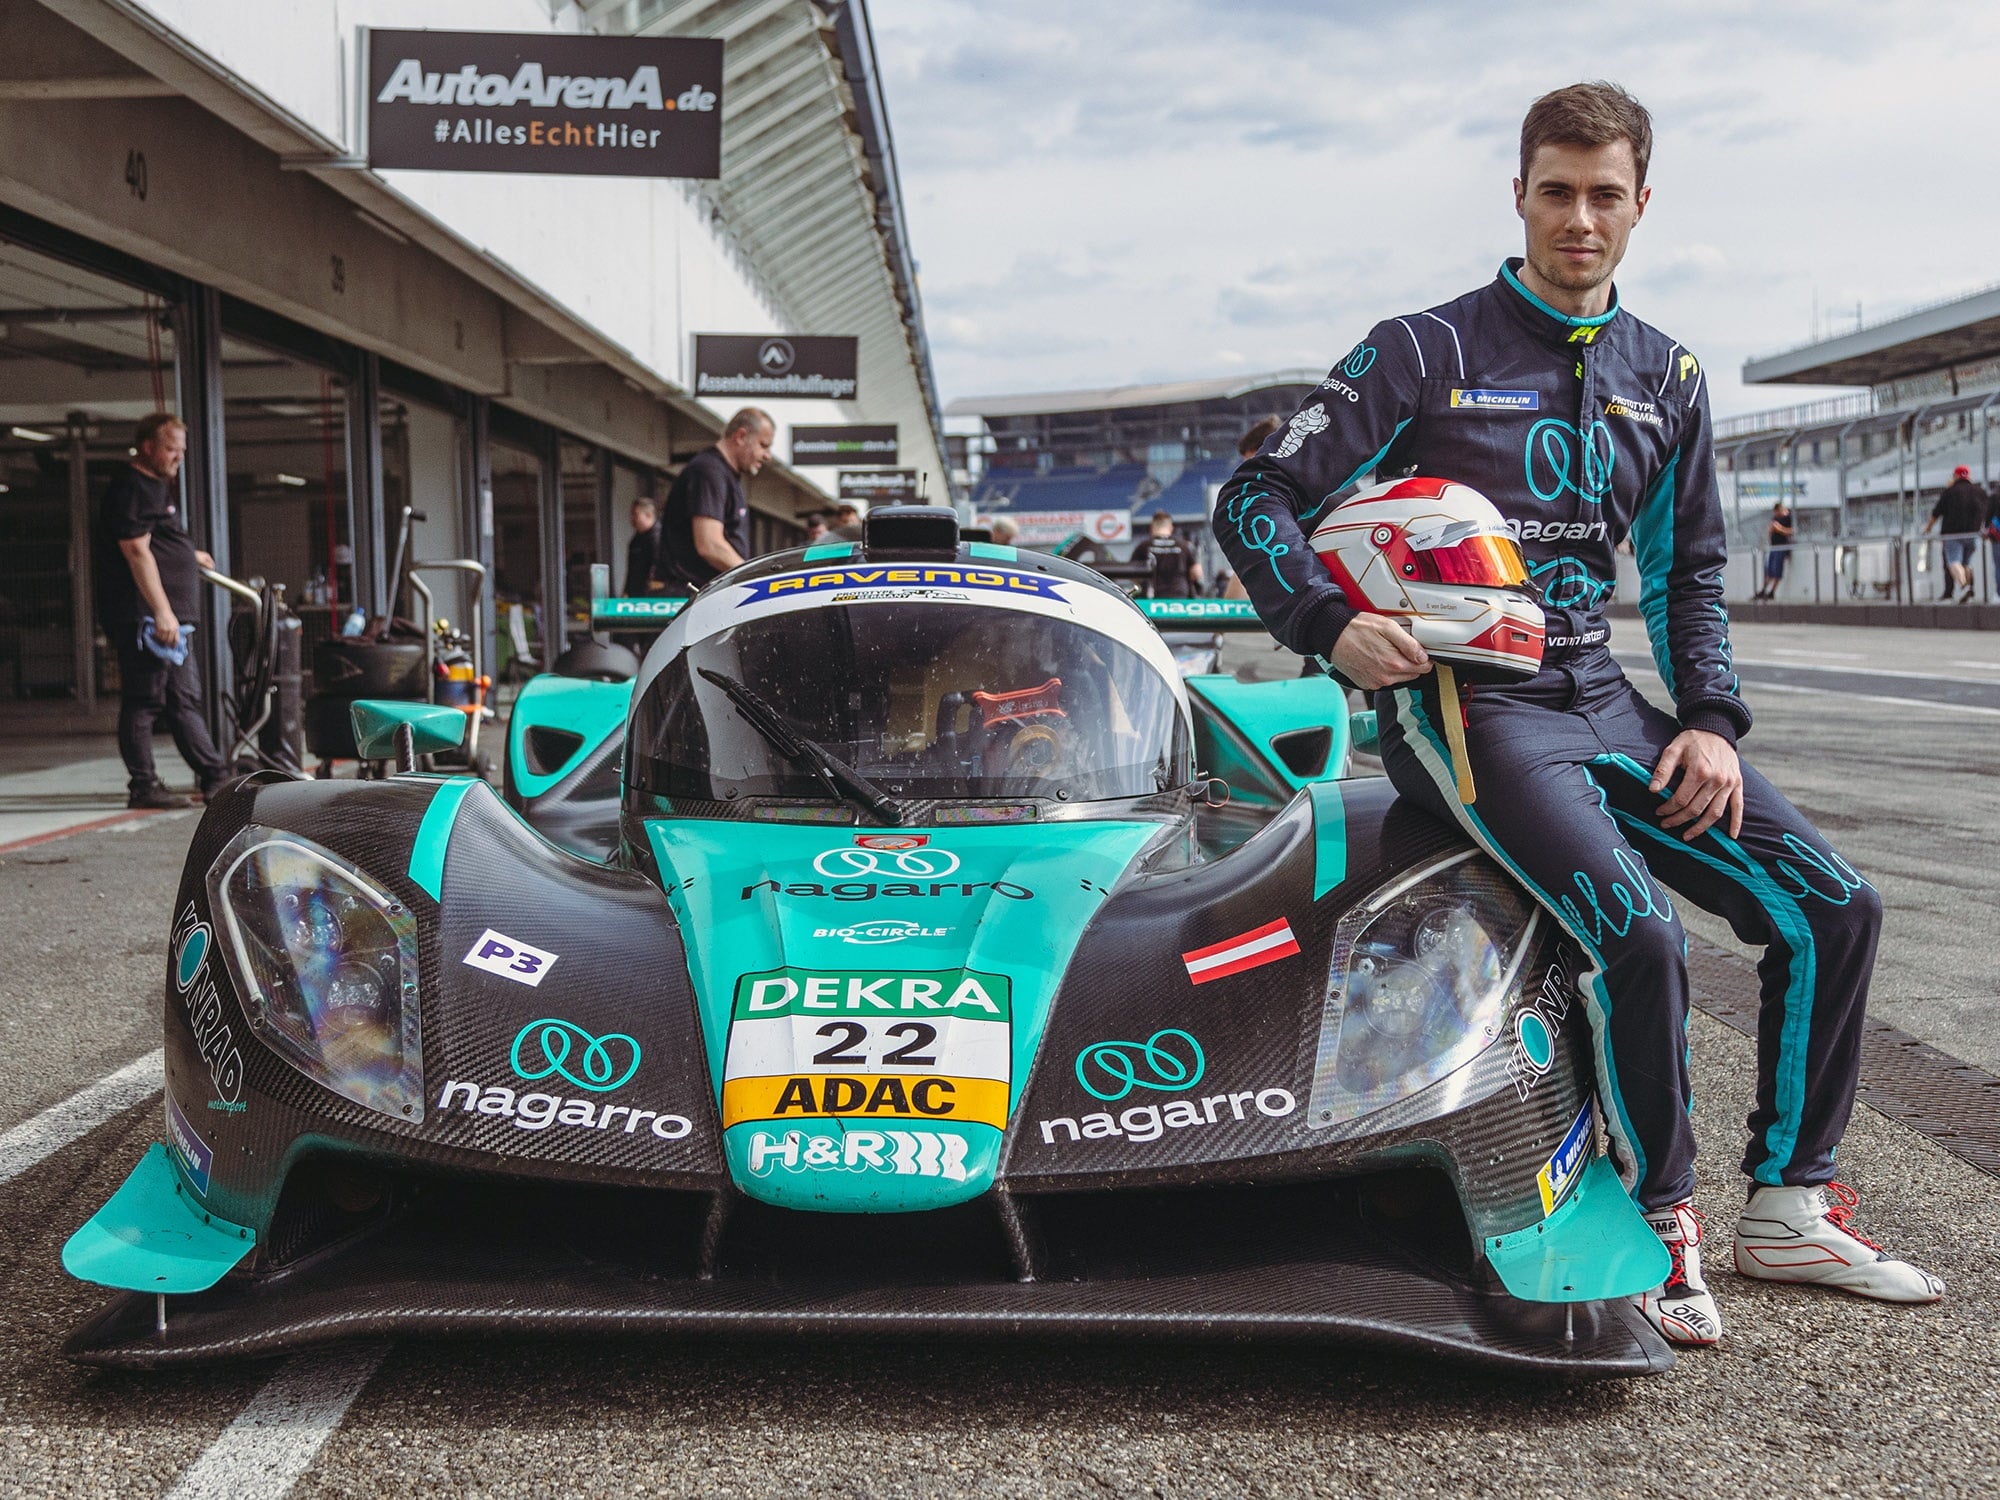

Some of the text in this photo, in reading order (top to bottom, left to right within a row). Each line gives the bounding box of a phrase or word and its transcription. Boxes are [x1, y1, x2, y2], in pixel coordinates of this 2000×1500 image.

[377, 59, 717, 112] AutoArenA.de
[433, 118, 662, 149] #AllesEchtHier
[125, 149, 148, 201] 40
[1475, 394, 1531, 405] MICHELIN
[768, 569, 1040, 594] RAVENOL
[738, 879, 1035, 902] nagarro
[812, 925, 948, 939] BIO-CIRCLE
[477, 939, 543, 974] P3
[172, 899, 243, 1105] KONRAD
[749, 977, 1001, 1013] DEKRA
[812, 1021, 938, 1066] 22
[438, 1080, 693, 1139] nagarro
[772, 1077, 956, 1116] ADAC
[1039, 1088, 1297, 1144] nagarro
[750, 1131, 892, 1178] H&R
[1672, 1306, 1714, 1334] OMP
